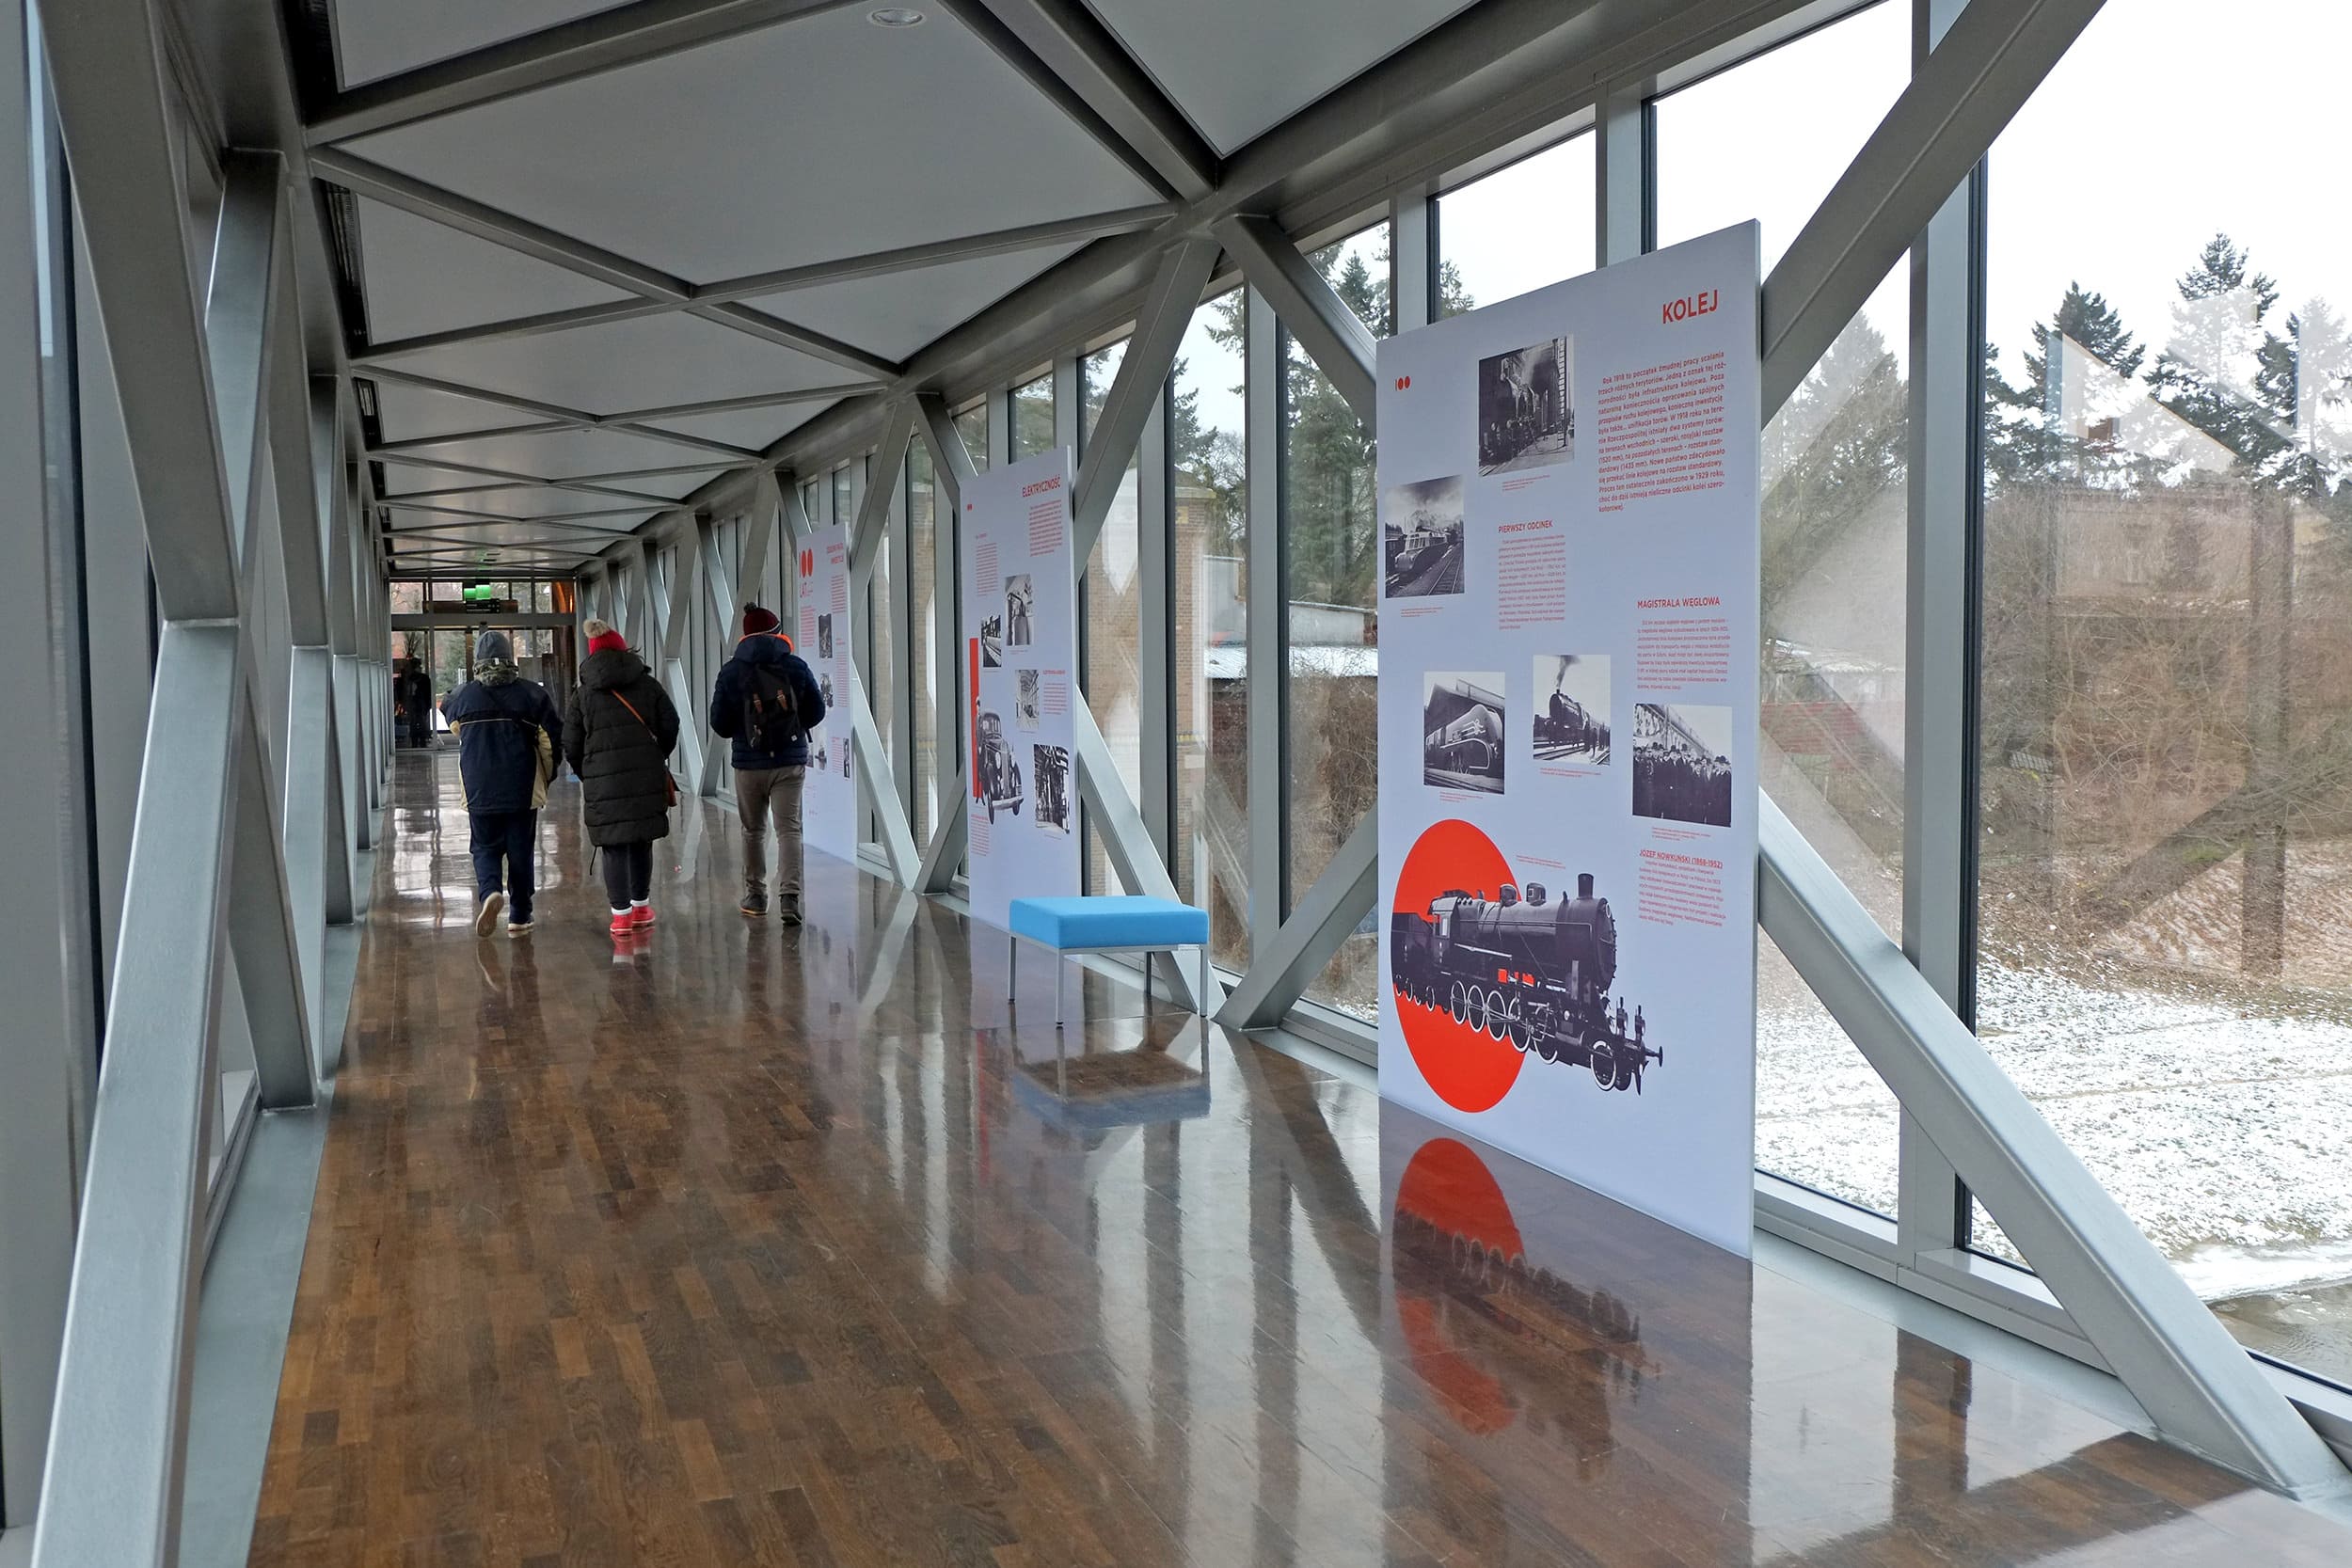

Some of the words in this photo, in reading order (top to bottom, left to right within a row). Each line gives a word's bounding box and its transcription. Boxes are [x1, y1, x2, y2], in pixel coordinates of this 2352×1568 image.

[1662, 289, 1718, 325] KOLEJ
[1022, 473, 1061, 498] ELEKTRYCZNOŚĆ
[1498, 522, 1525, 533] PIERWSZY
[1526, 519, 1553, 531] ODCINEK
[1637, 597, 1680, 609] MAGISTRALA
[1682, 595, 1721, 609] WĘGLOWA
